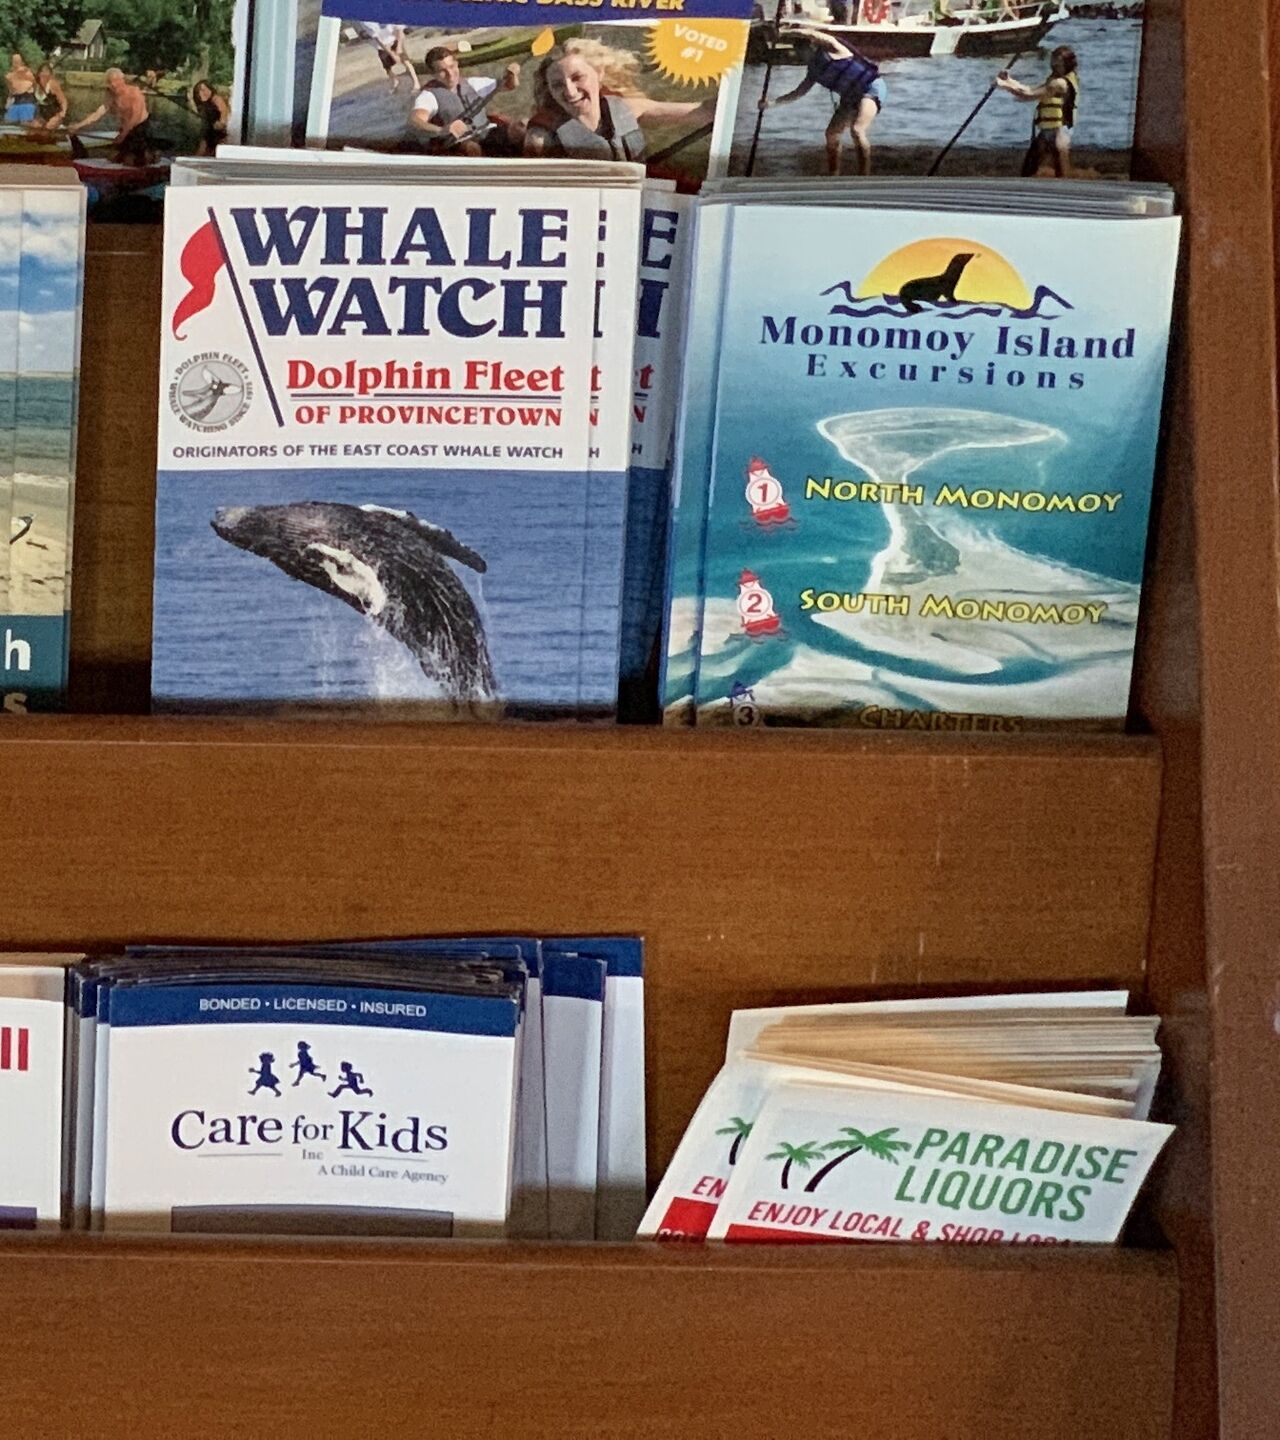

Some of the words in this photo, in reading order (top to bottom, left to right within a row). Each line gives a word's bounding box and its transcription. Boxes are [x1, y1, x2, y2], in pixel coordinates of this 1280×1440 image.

[229, 207, 568, 268] WHALE
[249, 278, 565, 339] WATCH
[760, 315, 975, 361] Monomoy
[996, 326, 1137, 361] Island
[287, 360, 452, 394] Dolphin
[463, 361, 565, 392] Fleet
[806, 354, 1086, 391] Excursions
[171, 1109, 283, 1150] Care
[292, 1114, 334, 1143] for
[337, 1110, 450, 1154] Kids
[913, 1127, 1138, 1185] PARADISE
[895, 1165, 1092, 1222] LIQUORS
